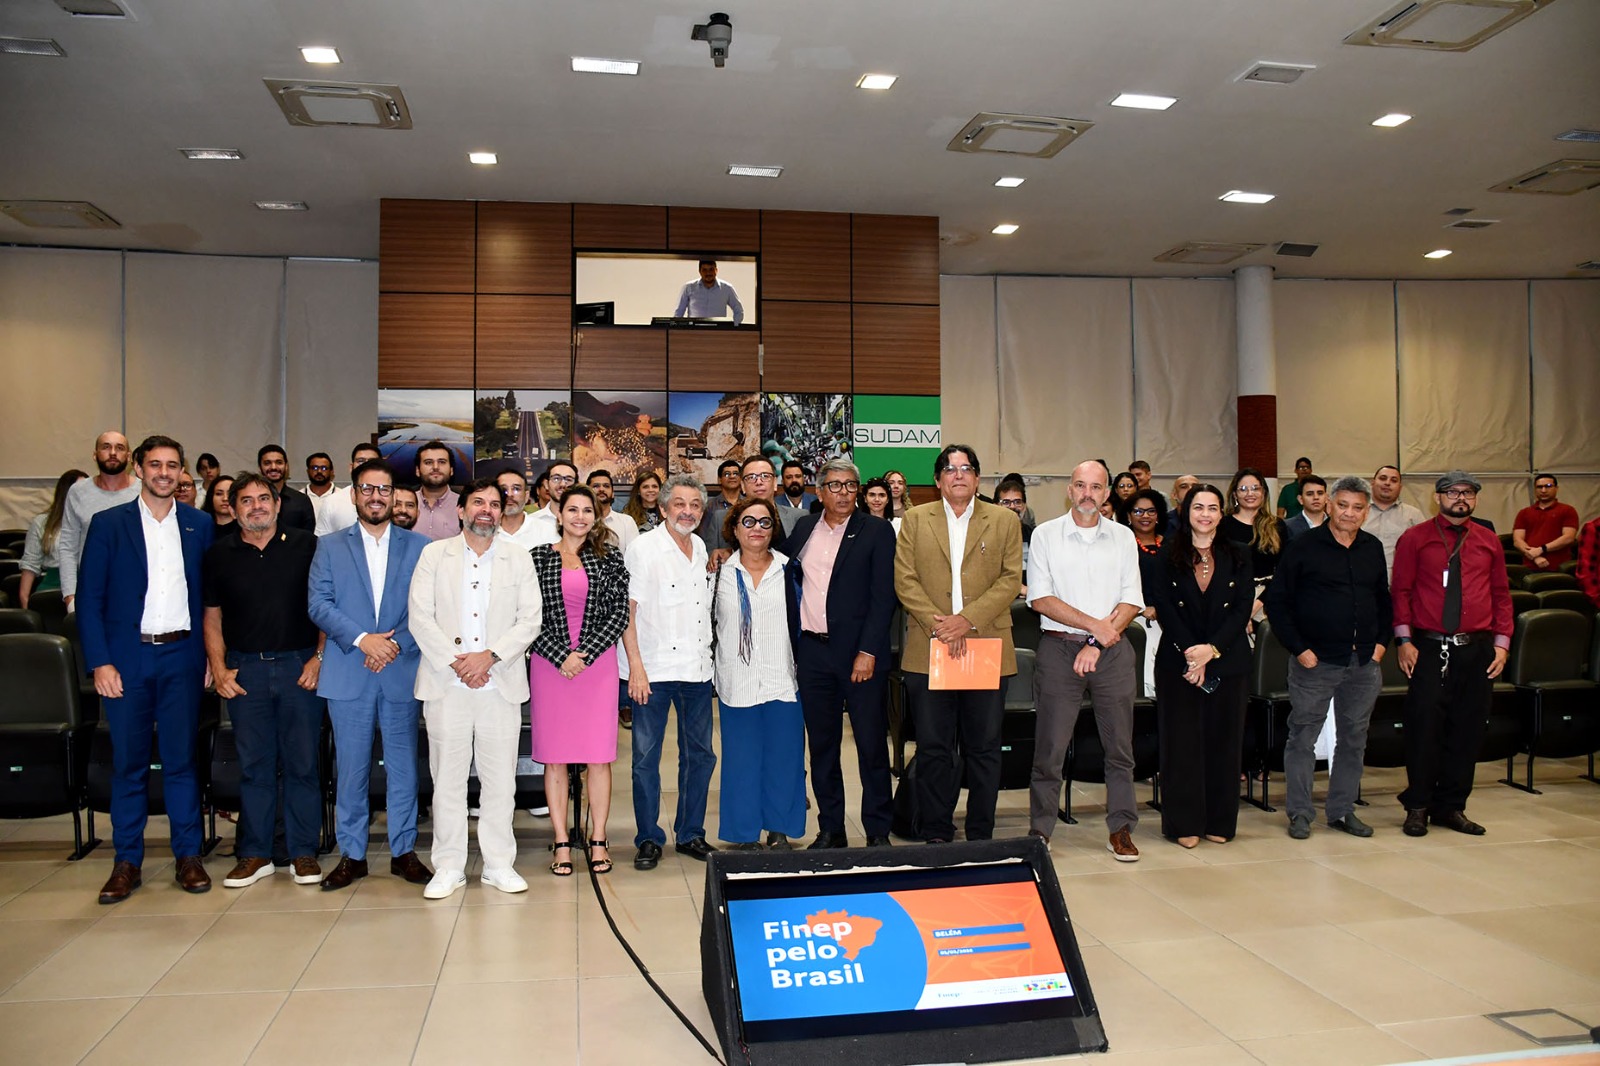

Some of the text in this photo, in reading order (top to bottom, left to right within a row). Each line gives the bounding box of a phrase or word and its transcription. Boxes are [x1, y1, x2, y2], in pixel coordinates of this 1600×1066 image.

[854, 428, 940, 444] SUDAM
[763, 920, 853, 941] Finep
[766, 940, 838, 968] pelo
[770, 963, 865, 989] Brasil
